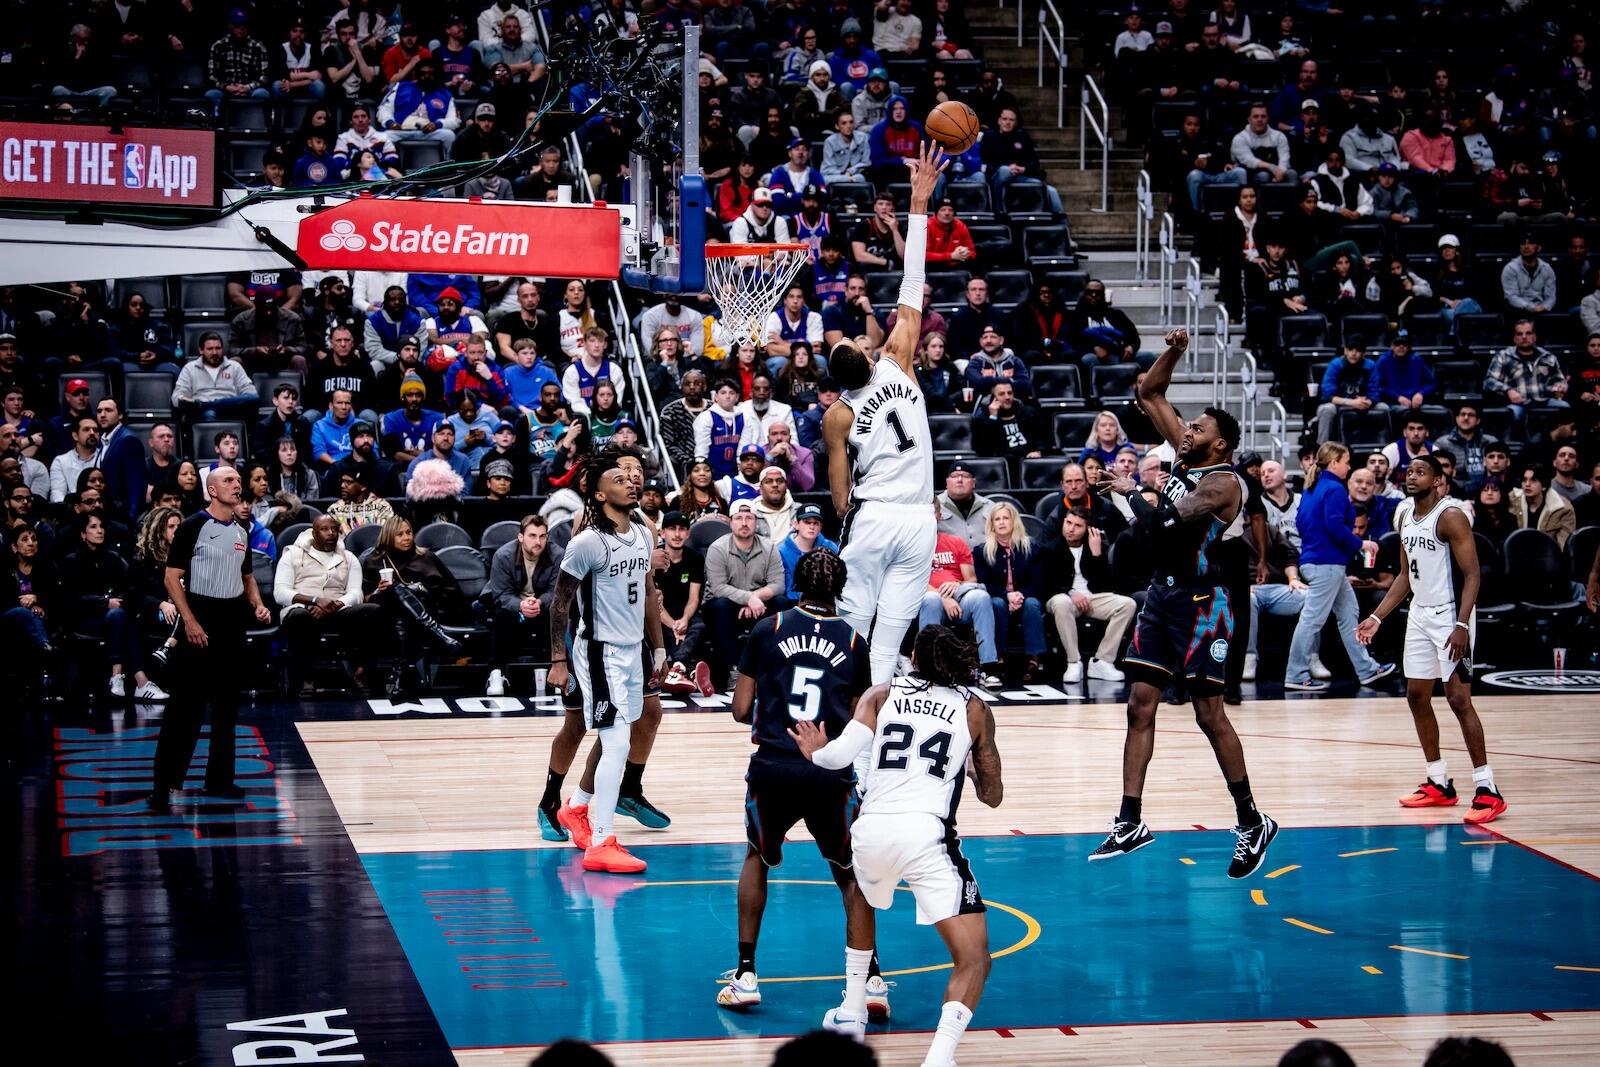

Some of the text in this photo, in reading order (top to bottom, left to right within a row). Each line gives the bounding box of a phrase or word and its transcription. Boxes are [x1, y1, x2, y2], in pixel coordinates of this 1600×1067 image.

[3, 138, 197, 198] GET THE App
[370, 221, 529, 255] State Farm
[324, 376, 362, 393] DETROIT
[857, 384, 918, 435] WEMBANYAMA
[886, 408, 917, 453] 1
[1006, 432, 1028, 448] 23
[1402, 536, 1436, 552] PURS
[610, 557, 650, 577] SPURS
[1410, 559, 1420, 580] 4
[628, 583, 638, 605] 5
[777, 634, 848, 668] HOLLAND II
[788, 665, 824, 720] 5
[893, 698, 958, 724] VASSELL
[877, 722, 954, 780] 24
